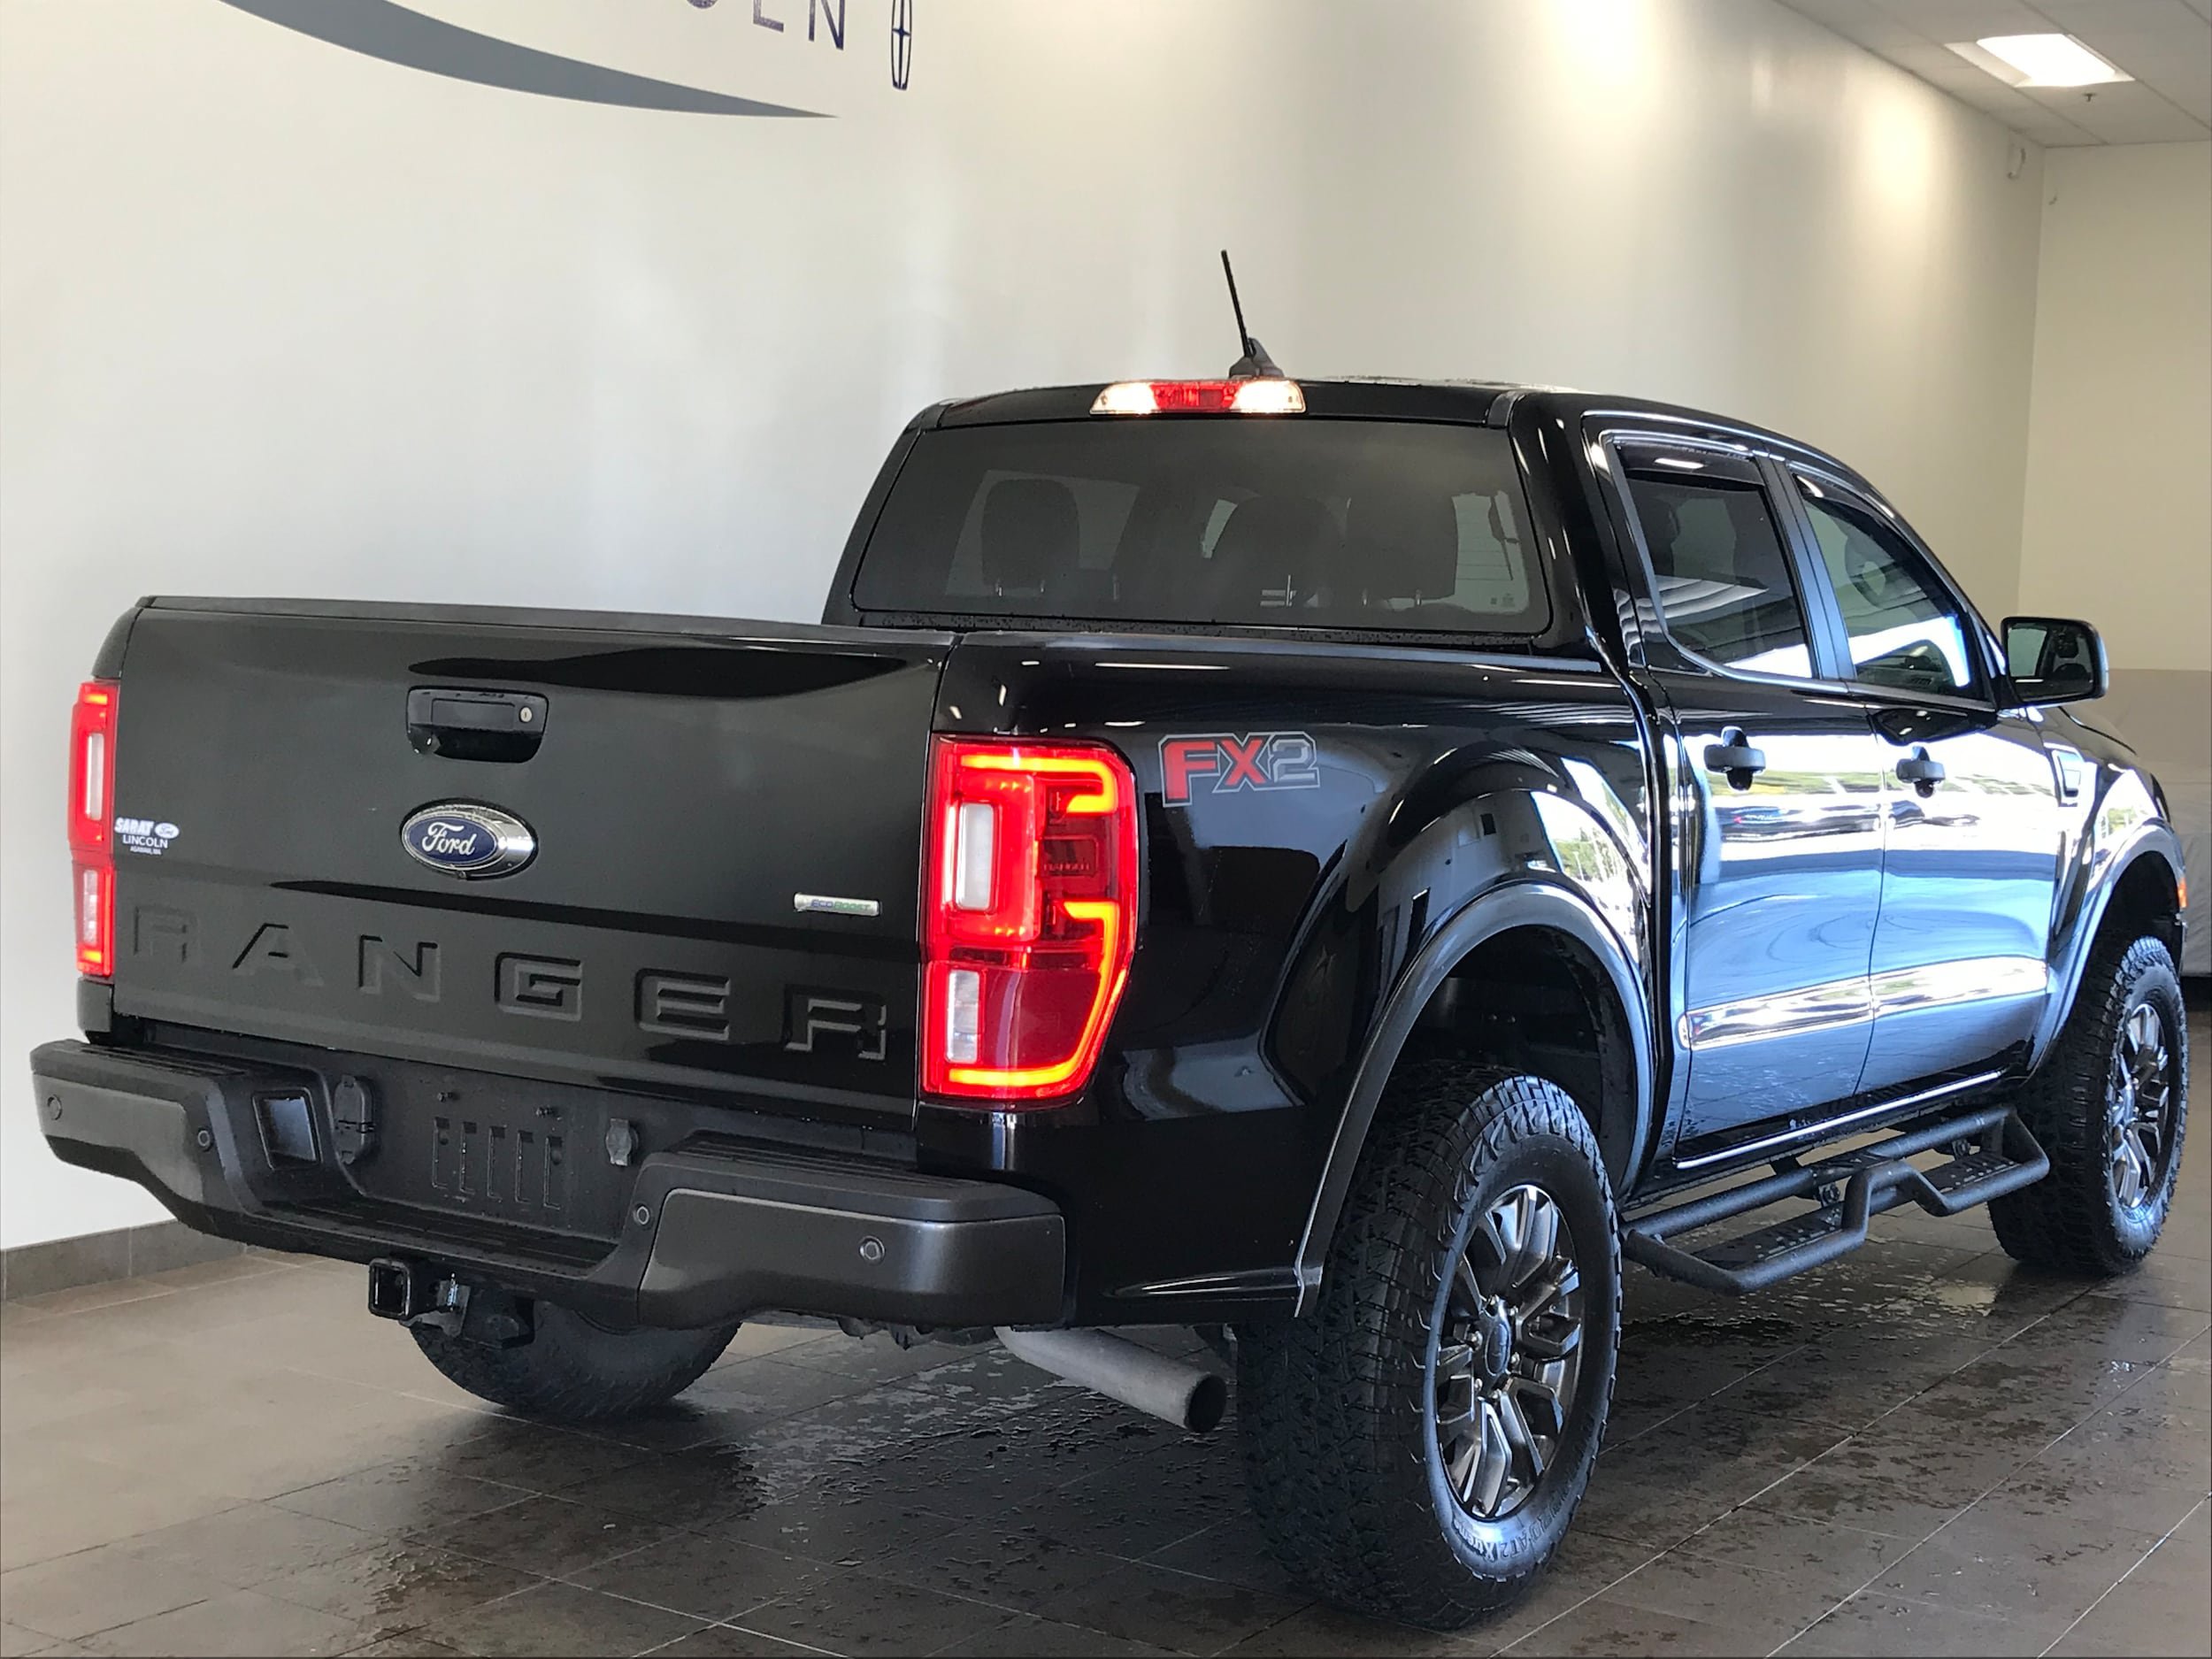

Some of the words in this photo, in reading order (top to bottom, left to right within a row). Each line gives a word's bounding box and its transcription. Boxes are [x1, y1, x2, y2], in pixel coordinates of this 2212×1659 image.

[1158, 731, 1321, 808] FX2
[114, 817, 155, 836] SARAT
[122, 834, 168, 849] LINCOLN
[422, 821, 478, 856] Ford
[134, 905, 887, 1061] RANGER
